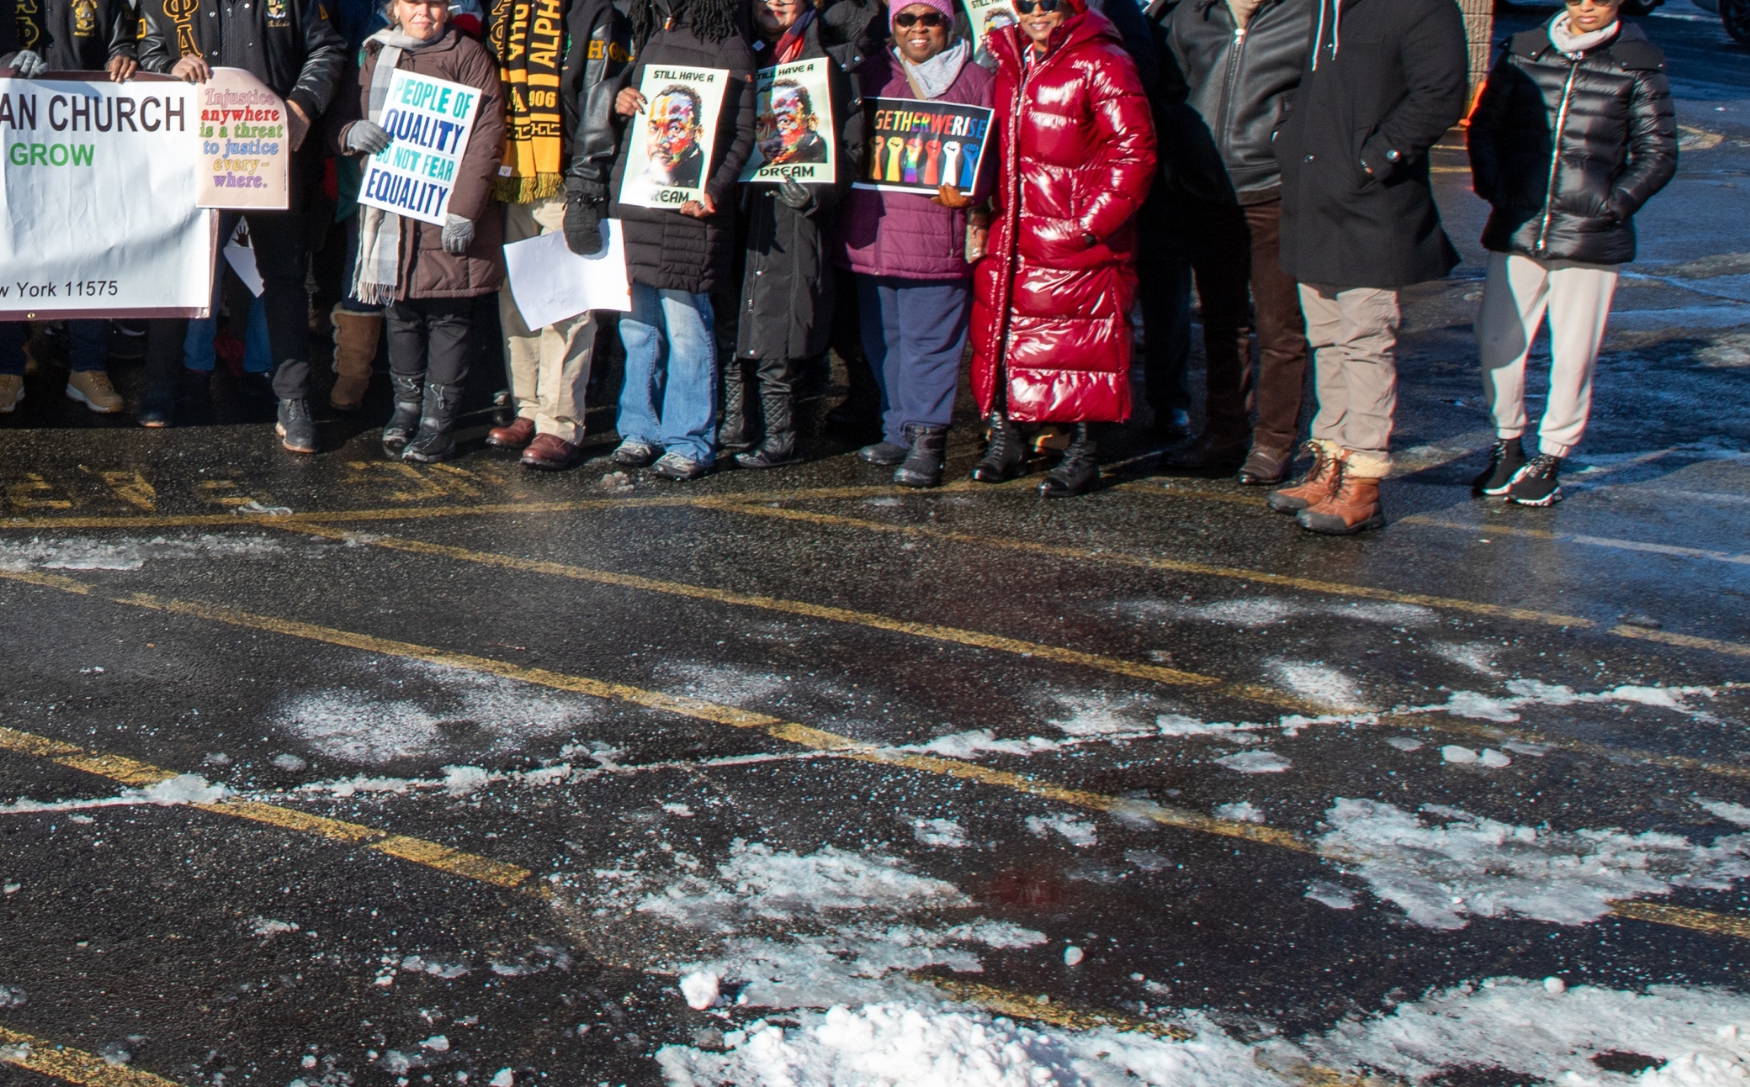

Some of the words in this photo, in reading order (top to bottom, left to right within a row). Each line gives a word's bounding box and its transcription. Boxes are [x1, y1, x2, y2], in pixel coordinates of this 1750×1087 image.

[653, 70, 677, 81] STILL
[679, 71, 705, 83] HAVE
[707, 73, 714, 83] A
[778, 64, 805, 76] HAVE
[807, 63, 813, 72] A
[204, 88, 275, 109] Injustice
[392, 77, 452, 115] PEOPLE
[453, 91, 474, 120] OF
[48, 95, 185, 132] CHURCH
[201, 105, 280, 125] anywhere
[199, 122, 214, 138] is
[219, 126, 228, 138] a
[234, 122, 283, 138] threat
[382, 108, 465, 155] QUALITY
[9, 142, 95, 167] GROW
[203, 140, 220, 155] to
[222, 138, 279, 159] justice
[213, 158, 269, 175] every-
[393, 147, 422, 172] NOT
[422, 155, 455, 182] FEAR
[759, 165, 814, 178] DREAM
[213, 171, 268, 189] where.
[365, 168, 449, 217] EQUALITY
[16, 282, 56, 297] York
[65, 281, 118, 297] 11575
